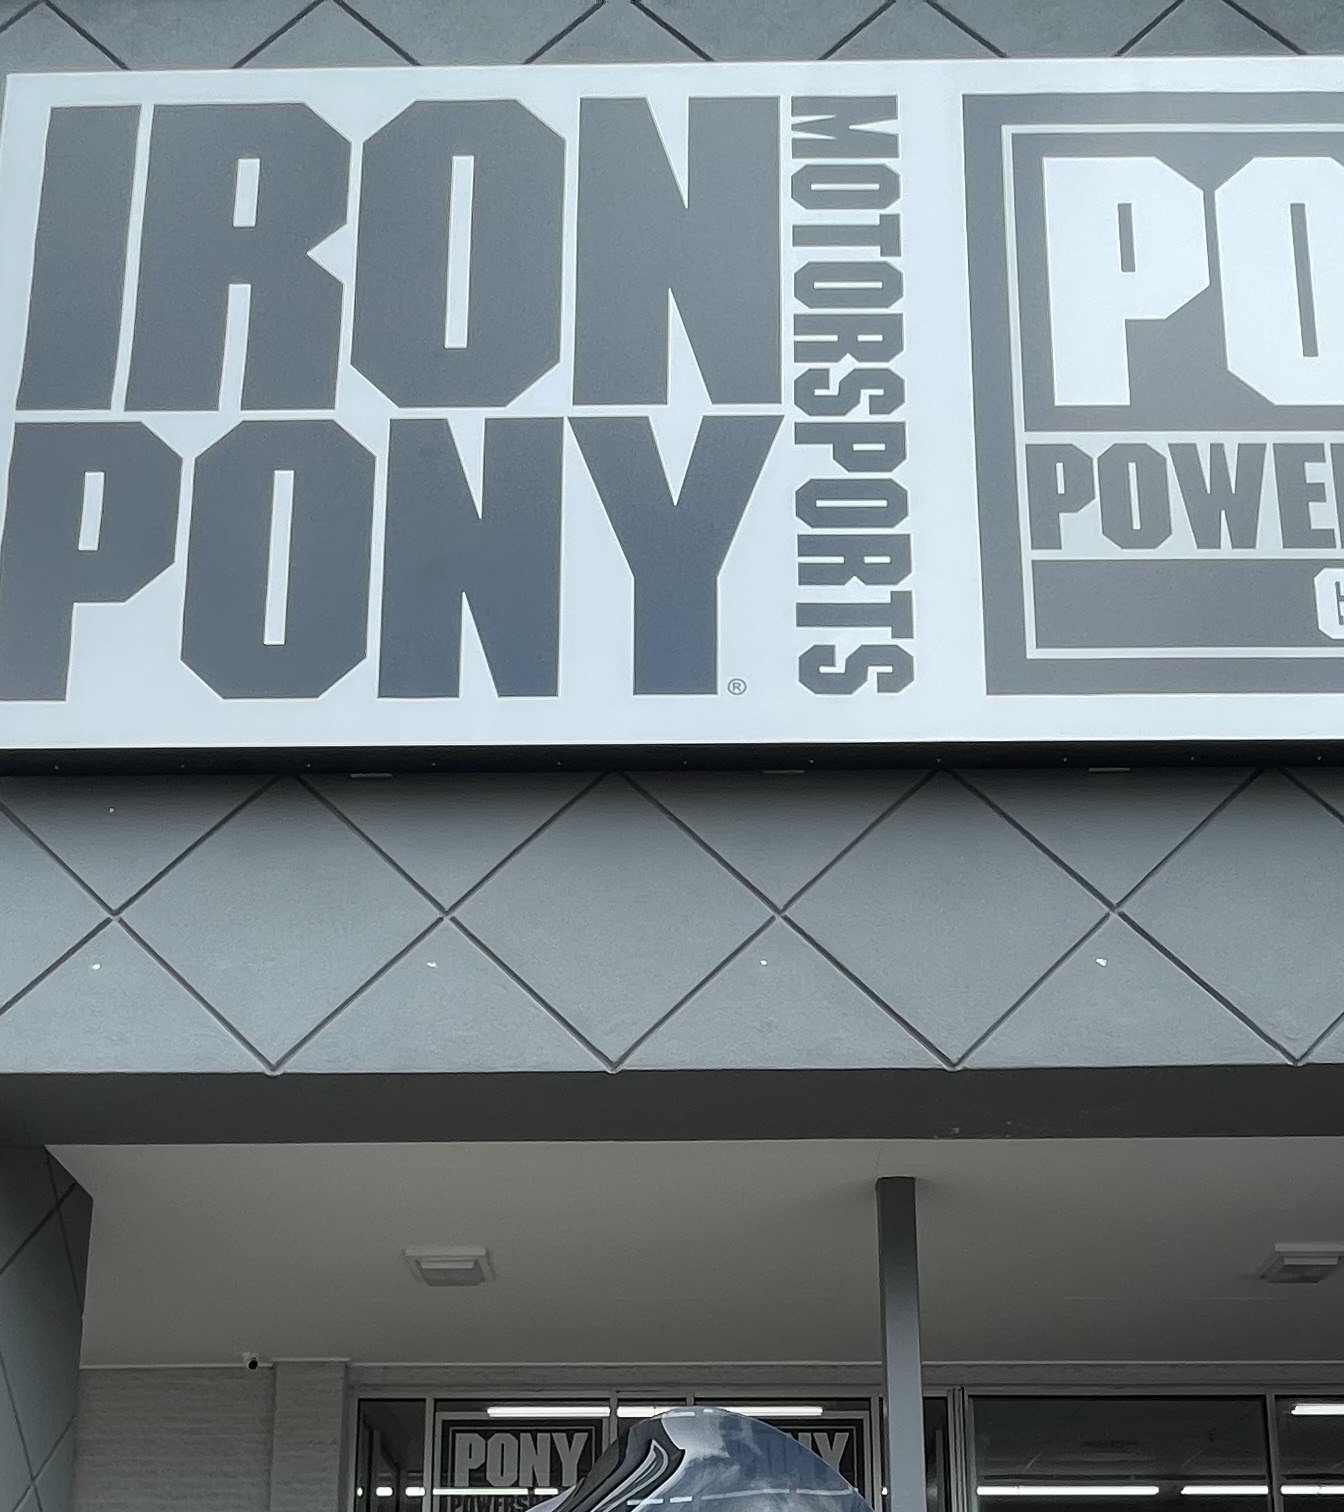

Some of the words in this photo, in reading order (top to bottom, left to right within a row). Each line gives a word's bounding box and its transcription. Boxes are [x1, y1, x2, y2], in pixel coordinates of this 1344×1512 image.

[15, 94, 783, 412] IRON
[790, 94, 915, 696] MOTORSPORTS
[455, 1432, 589, 1488] PONY
